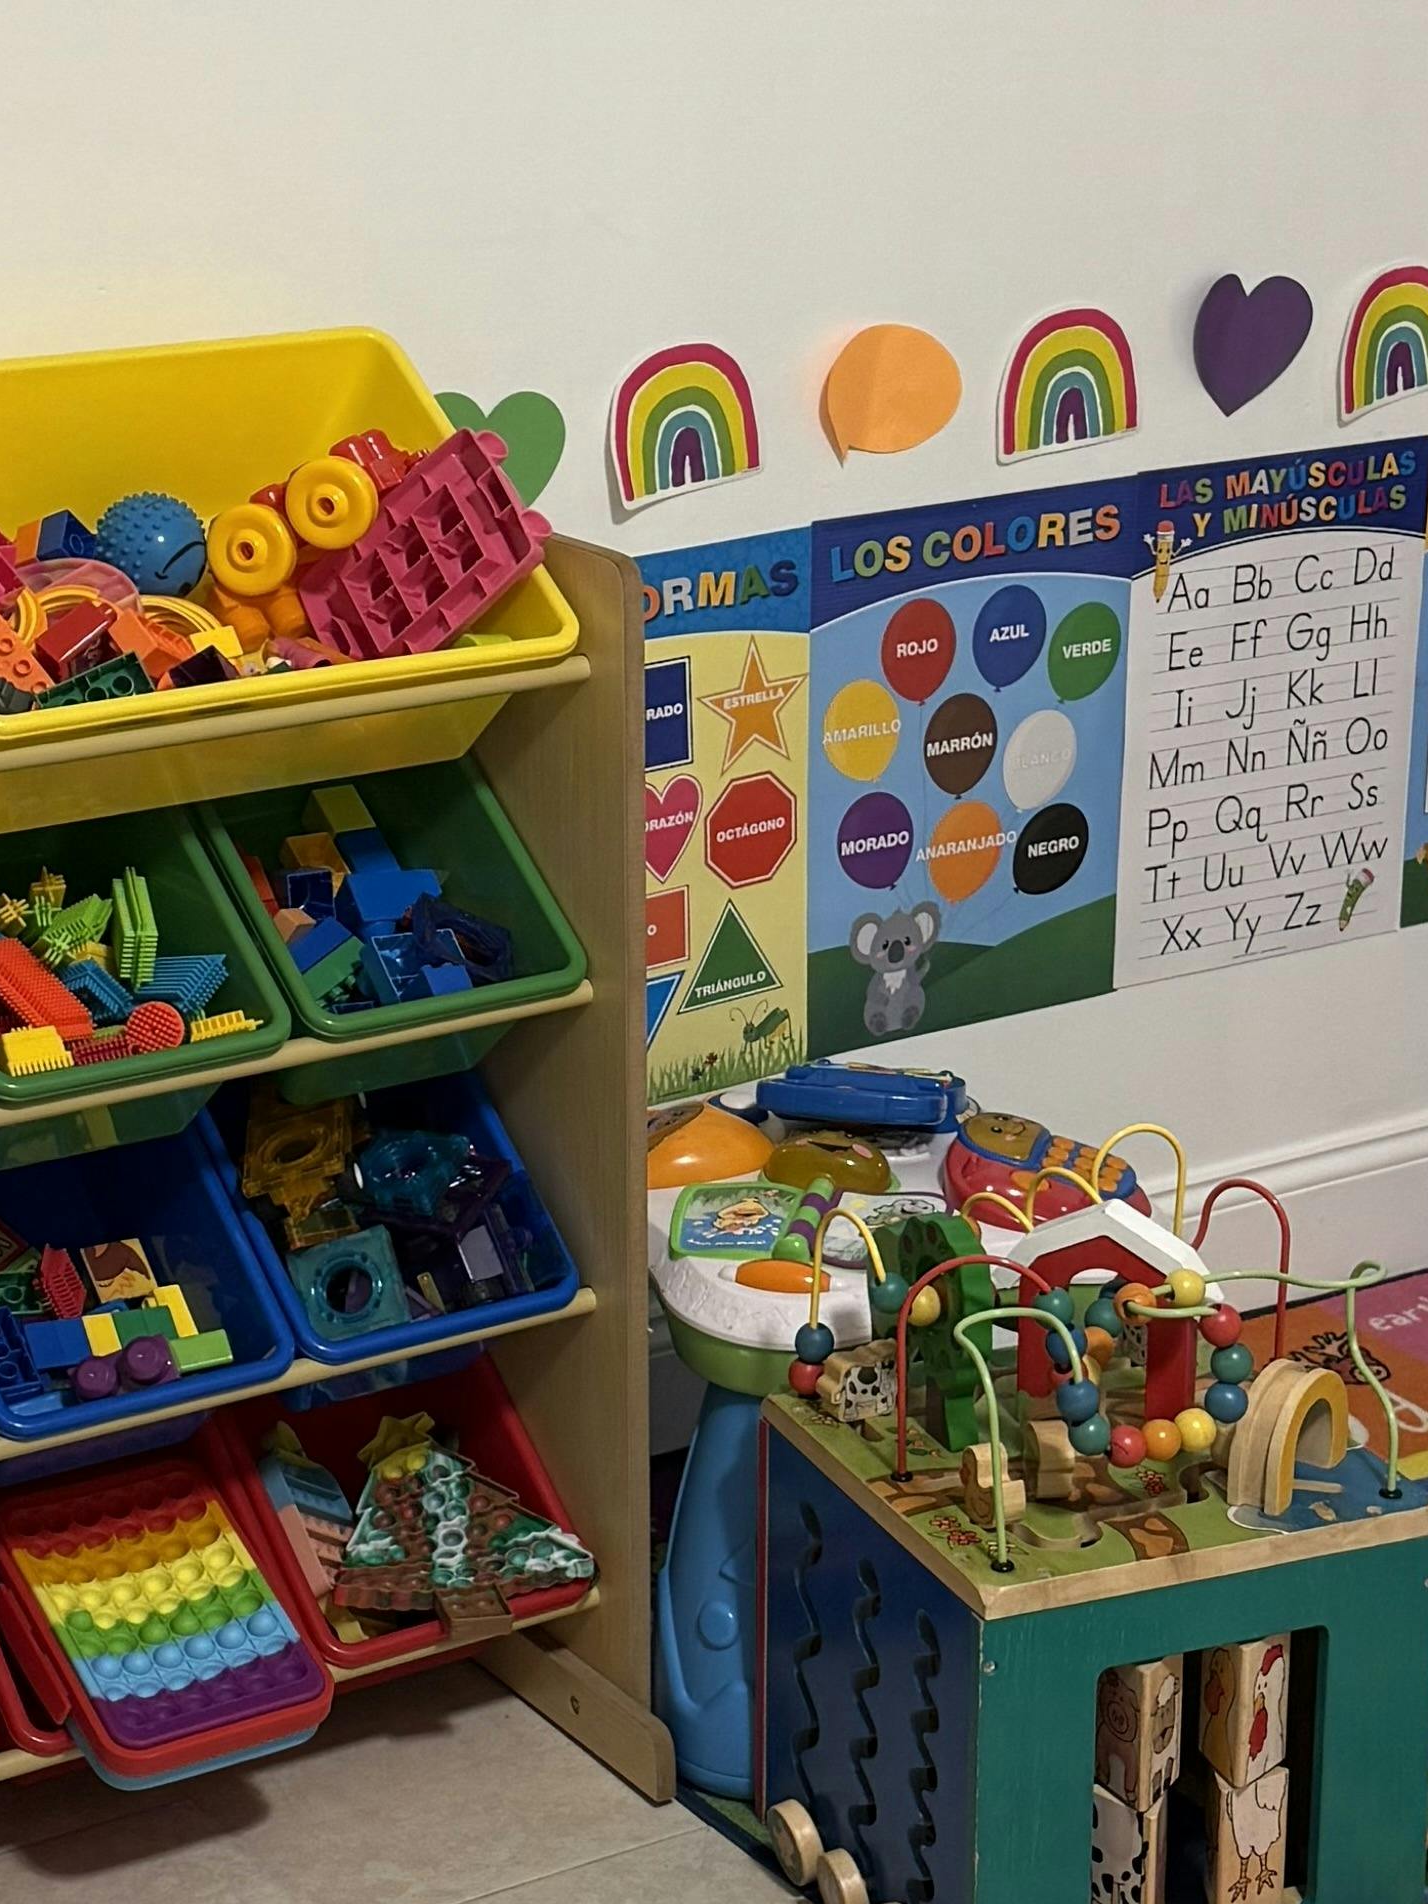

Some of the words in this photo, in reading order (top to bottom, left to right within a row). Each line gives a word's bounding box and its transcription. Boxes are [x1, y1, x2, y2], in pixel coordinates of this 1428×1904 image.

[1160, 476, 1213, 510] LAS
[1225, 450, 1416, 501] MAYÚSCULAS
[1192, 511, 1212, 539] Y
[1223, 484, 1406, 534] MINÚSCULAS
[831, 535, 912, 581] LOS
[922, 504, 1121, 566] COLORES
[1167, 573, 1211, 614] Aa
[1233, 564, 1273, 604] Bb
[1295, 554, 1334, 594] Cc
[1353, 546, 1395, 587] Dd
[896, 636, 939, 659] ROJO
[989, 621, 1031, 644] AZUL
[1168, 631, 1204, 672] Ee
[1230, 618, 1268, 662] Ff
[1062, 638, 1113, 659] VERDE
[723, 685, 786, 711] ESTRELLA
[822, 717, 903, 747] AMARILLO
[926, 730, 994, 758] MARRÓN
[1012, 745, 1074, 773] BLANCO
[716, 815, 786, 845] OCTÁGONO
[840, 829, 910, 858] MORADO
[916, 829, 1018, 863] ANARANJADO
[1027, 834, 1080, 858] NEGRO
[694, 969, 767, 1000] TRIÁNGULO
